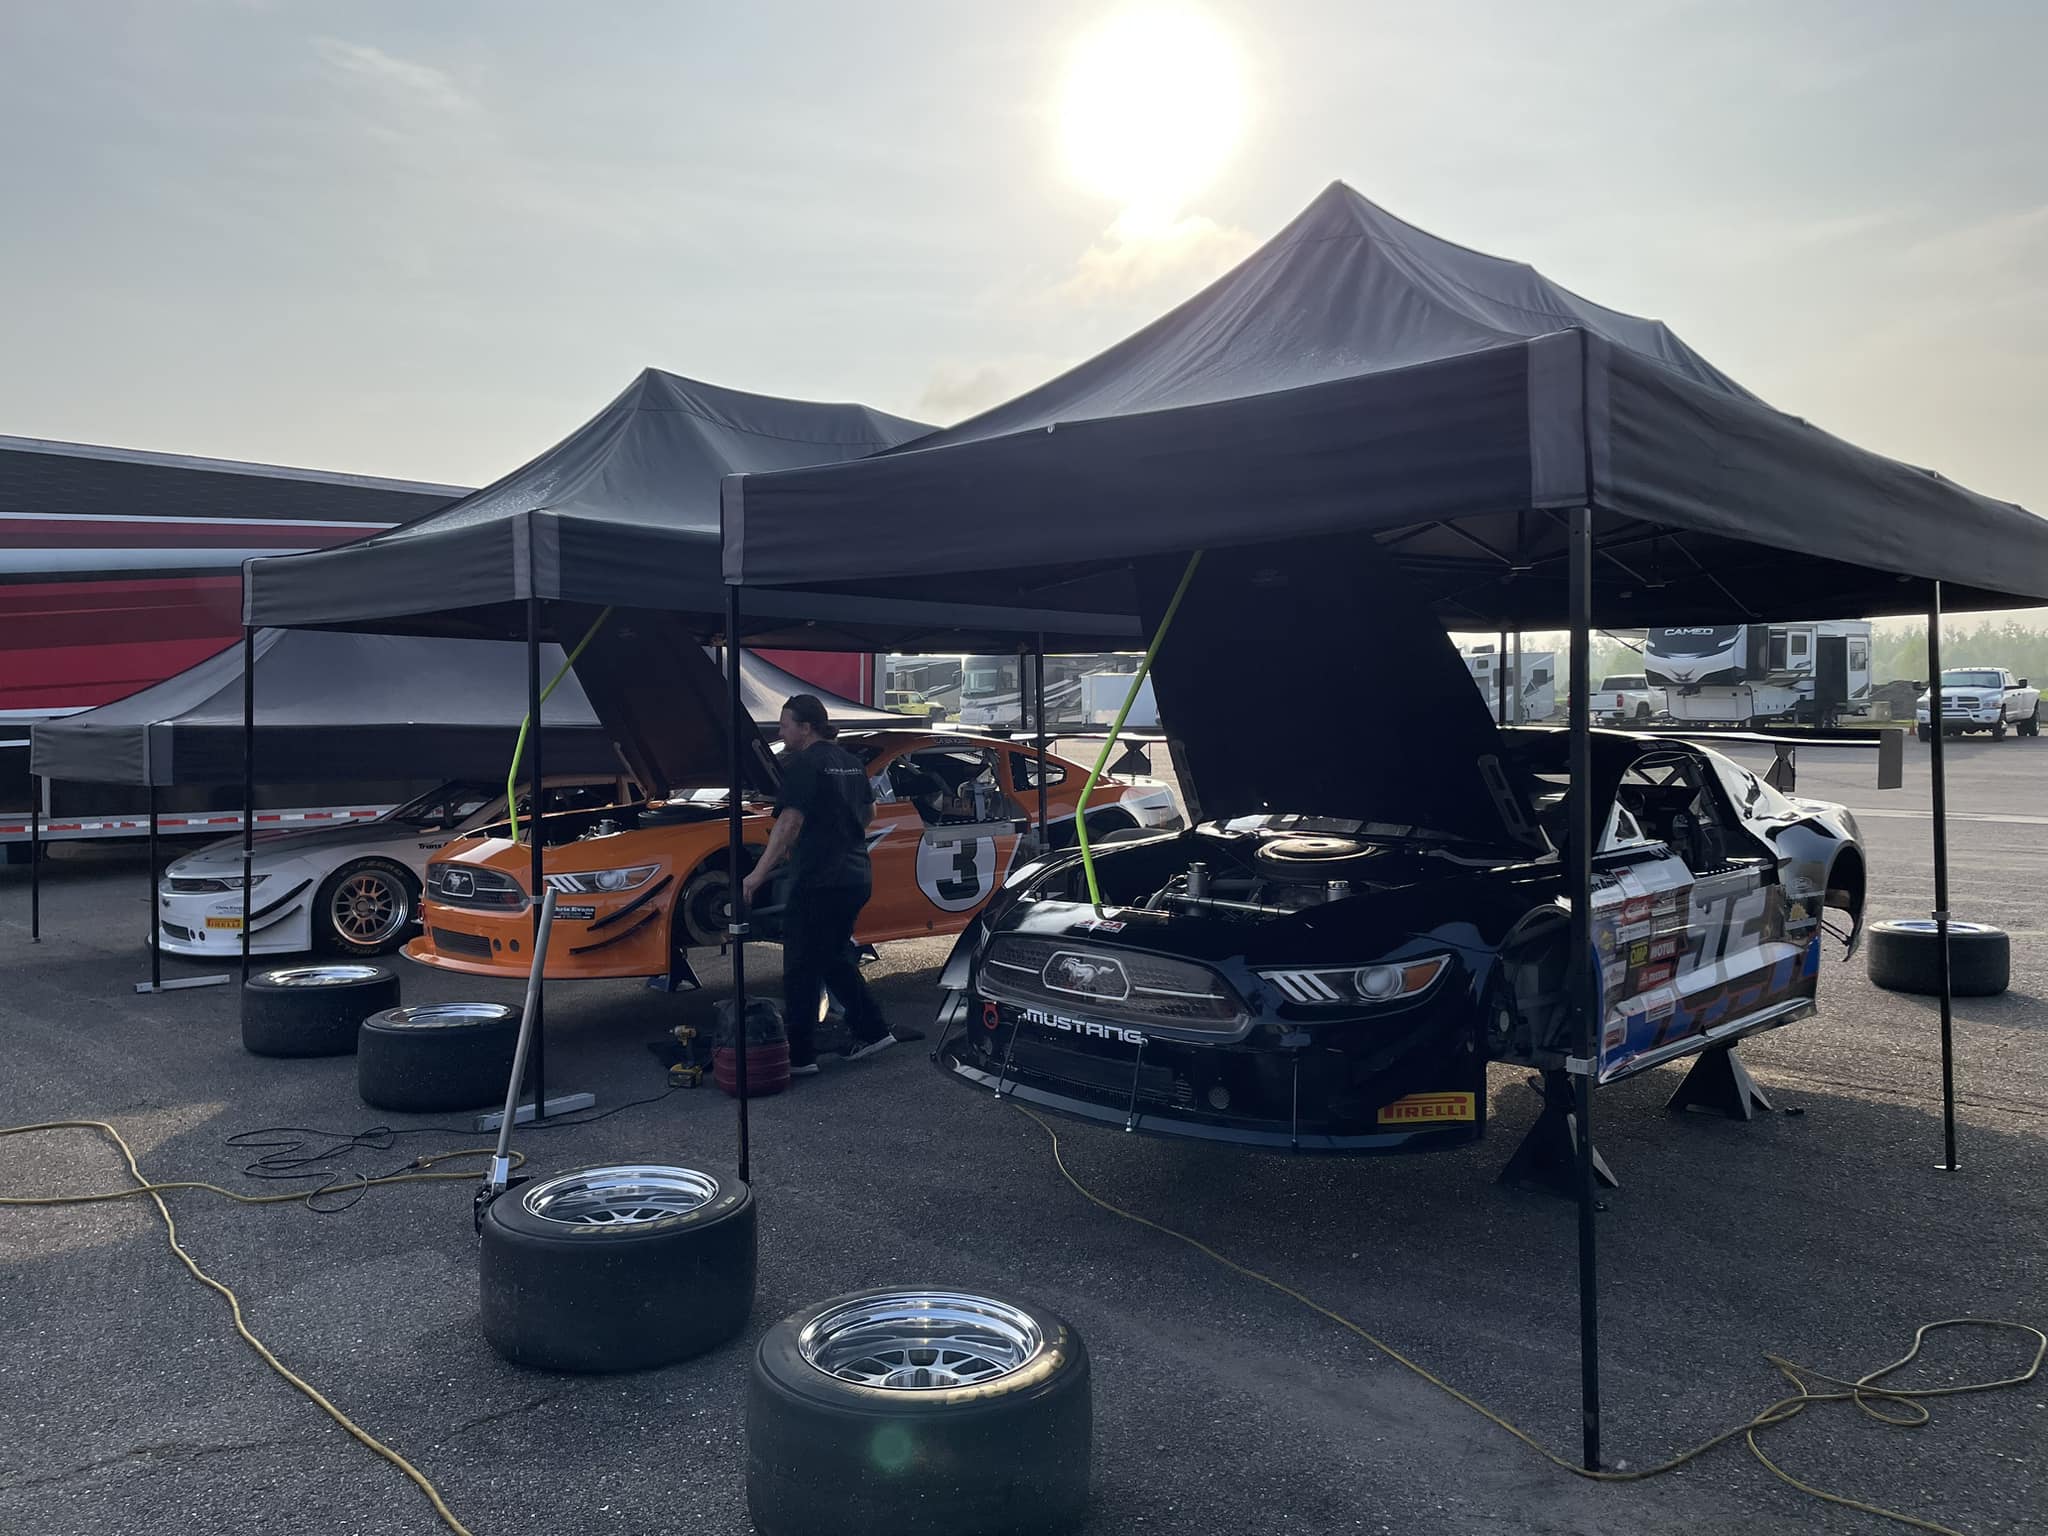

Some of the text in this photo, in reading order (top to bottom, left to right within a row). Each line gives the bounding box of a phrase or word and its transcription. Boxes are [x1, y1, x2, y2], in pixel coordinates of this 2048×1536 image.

[1664, 628, 1713, 636] CAMEO
[934, 837, 981, 901] 3
[1649, 941, 1676, 959] MOTUL
[1026, 1008, 1142, 1045] MUSTANG
[1383, 1096, 1468, 1119] PIRELLI
